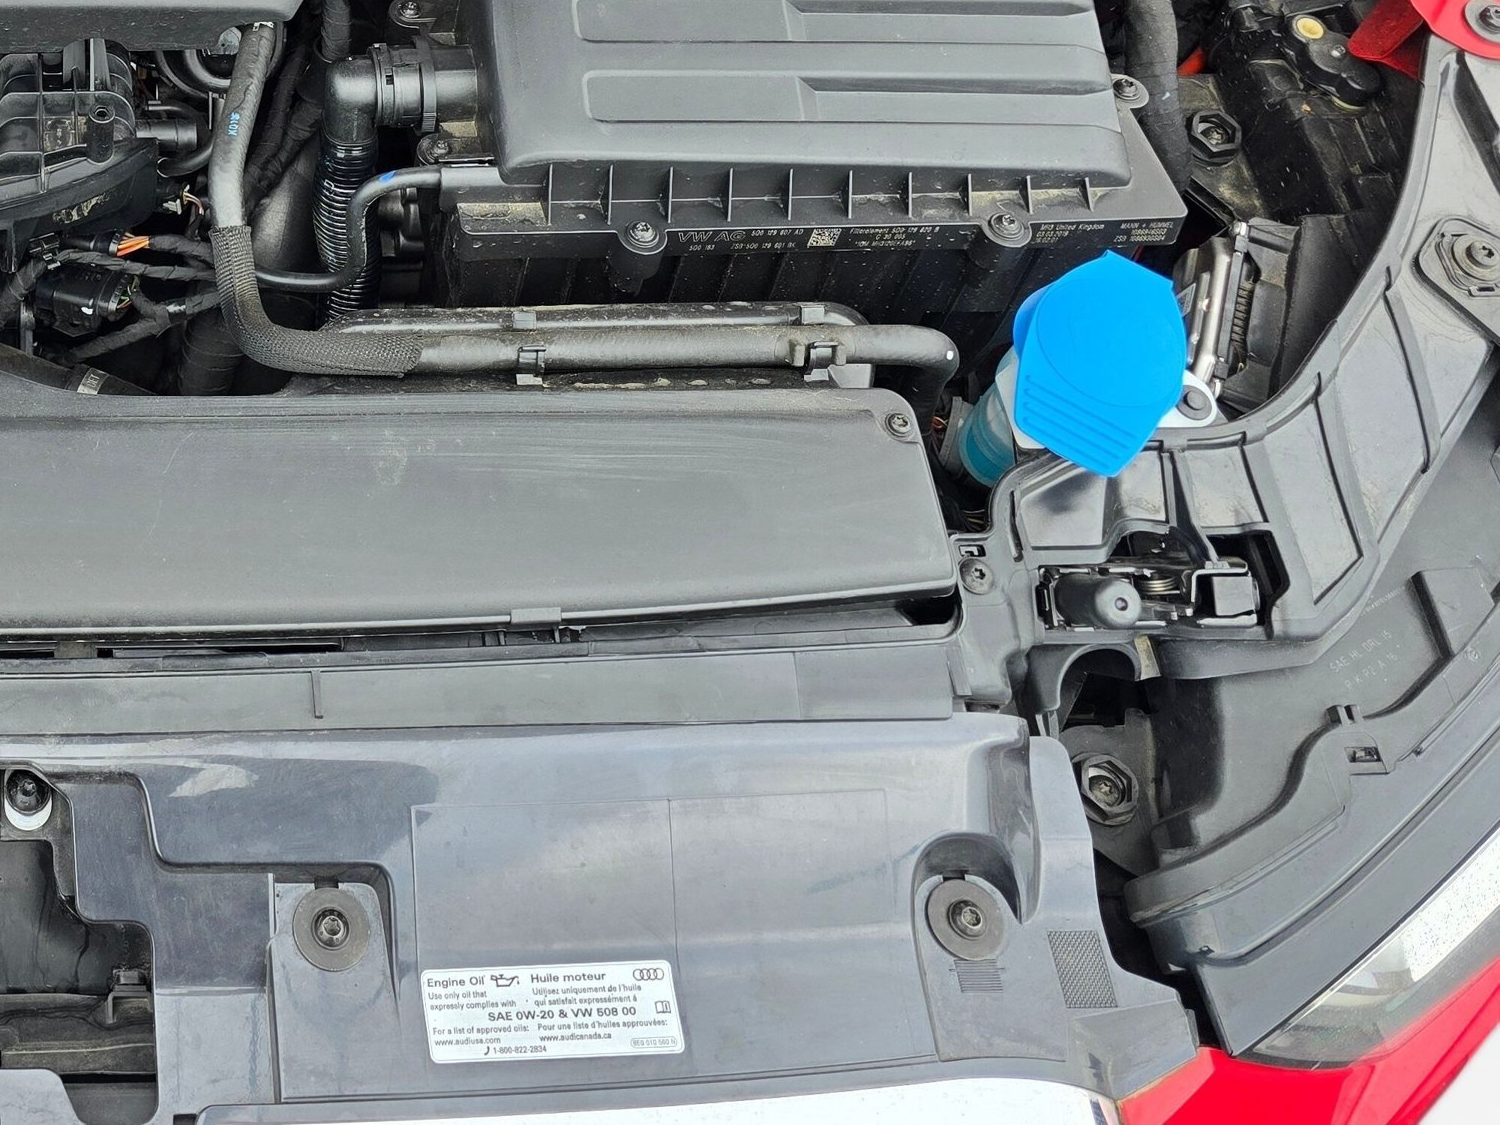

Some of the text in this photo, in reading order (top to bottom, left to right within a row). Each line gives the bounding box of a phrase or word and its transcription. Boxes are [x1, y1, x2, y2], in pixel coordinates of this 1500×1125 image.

[1054, 223, 1077, 232] United
[1077, 221, 1106, 231] Kingdom
[677, 231, 745, 242] VW AG
[426, 976, 484, 988] Engine Oil
[530, 972, 606, 982] Huile moteur
[443, 991, 460, 1000] only
[532, 987, 559, 997] Utilisez
[561, 985, 606, 995] uniquement
[618, 983, 641, 991] l'huile
[430, 1002, 464, 1011] expressly
[465, 1000, 499, 1010] complies
[533, 999, 546, 1007] qui
[547, 996, 577, 1005] satisfait
[578, 994, 631, 1005] expressément
[487, 1006, 636, 1021] SAE 0W-20 & VW 508 00
[475, 1025, 512, 1034] approved
[513, 1024, 529, 1032] oils:
[537, 1022, 555, 1030] Pour
[590, 1020, 620, 1028] d'huiles
[621, 1018, 667, 1028] approuvées:
[434, 1036, 501, 1046] www.audiusa.com
[539, 1031, 611, 1041] www.audicanada.ca
[493, 1045, 546, 1054] 1-800-822-2834
